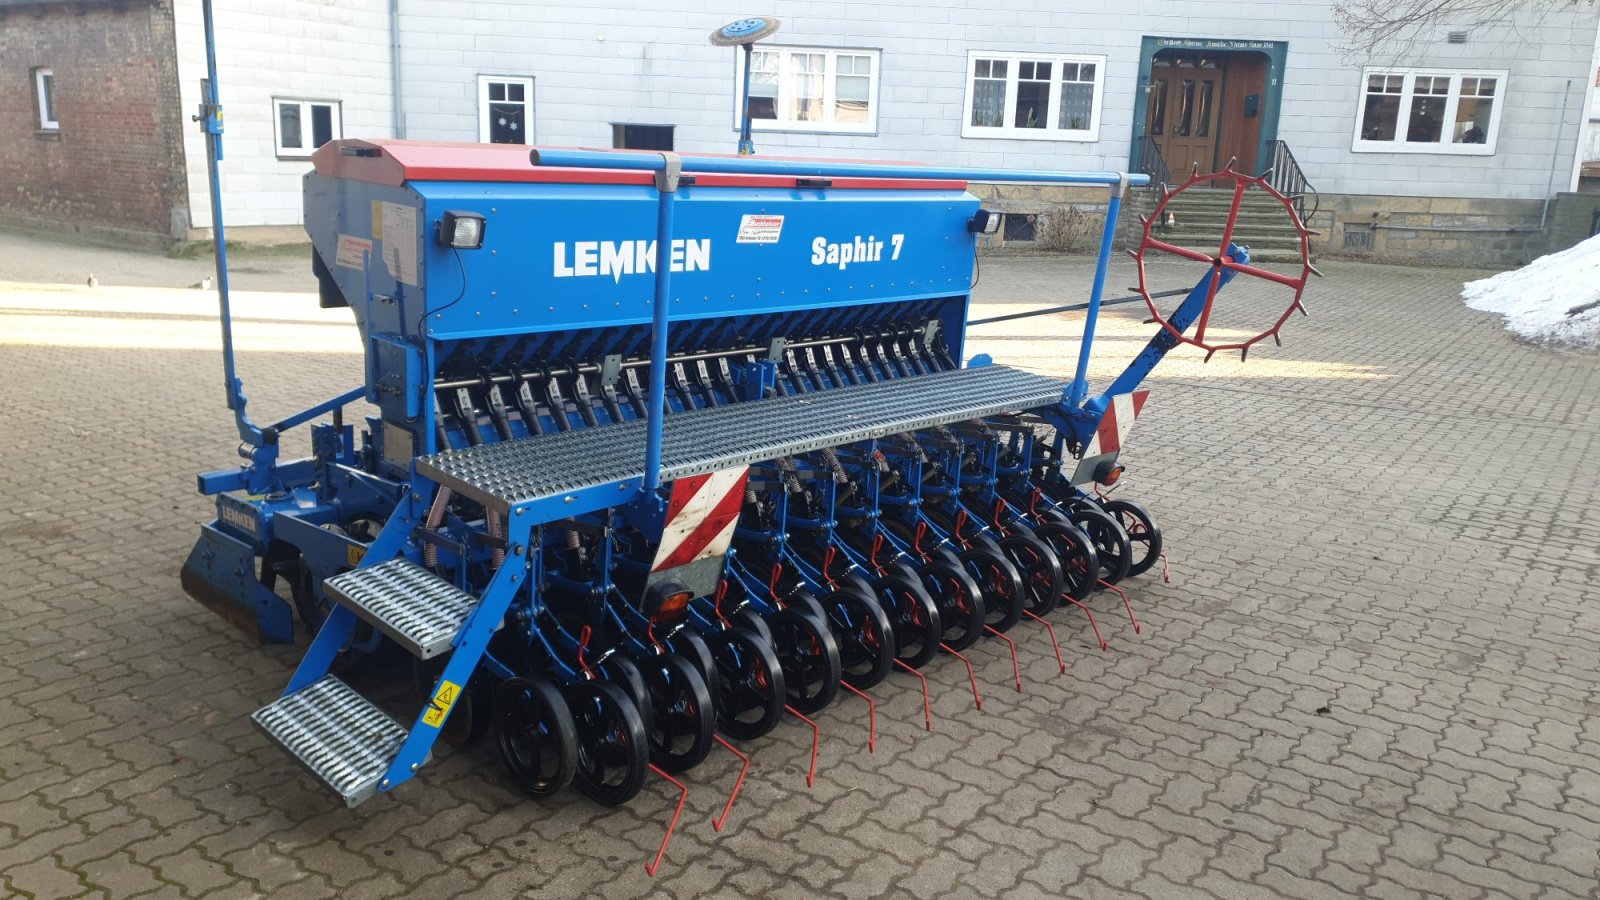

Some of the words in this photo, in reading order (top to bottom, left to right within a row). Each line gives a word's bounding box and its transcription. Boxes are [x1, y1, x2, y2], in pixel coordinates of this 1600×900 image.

[553, 238, 711, 285] LEMKEN
[811, 235, 884, 270] Saphir
[891, 233, 905, 260] 7
[222, 504, 256, 532] LEMKEN
